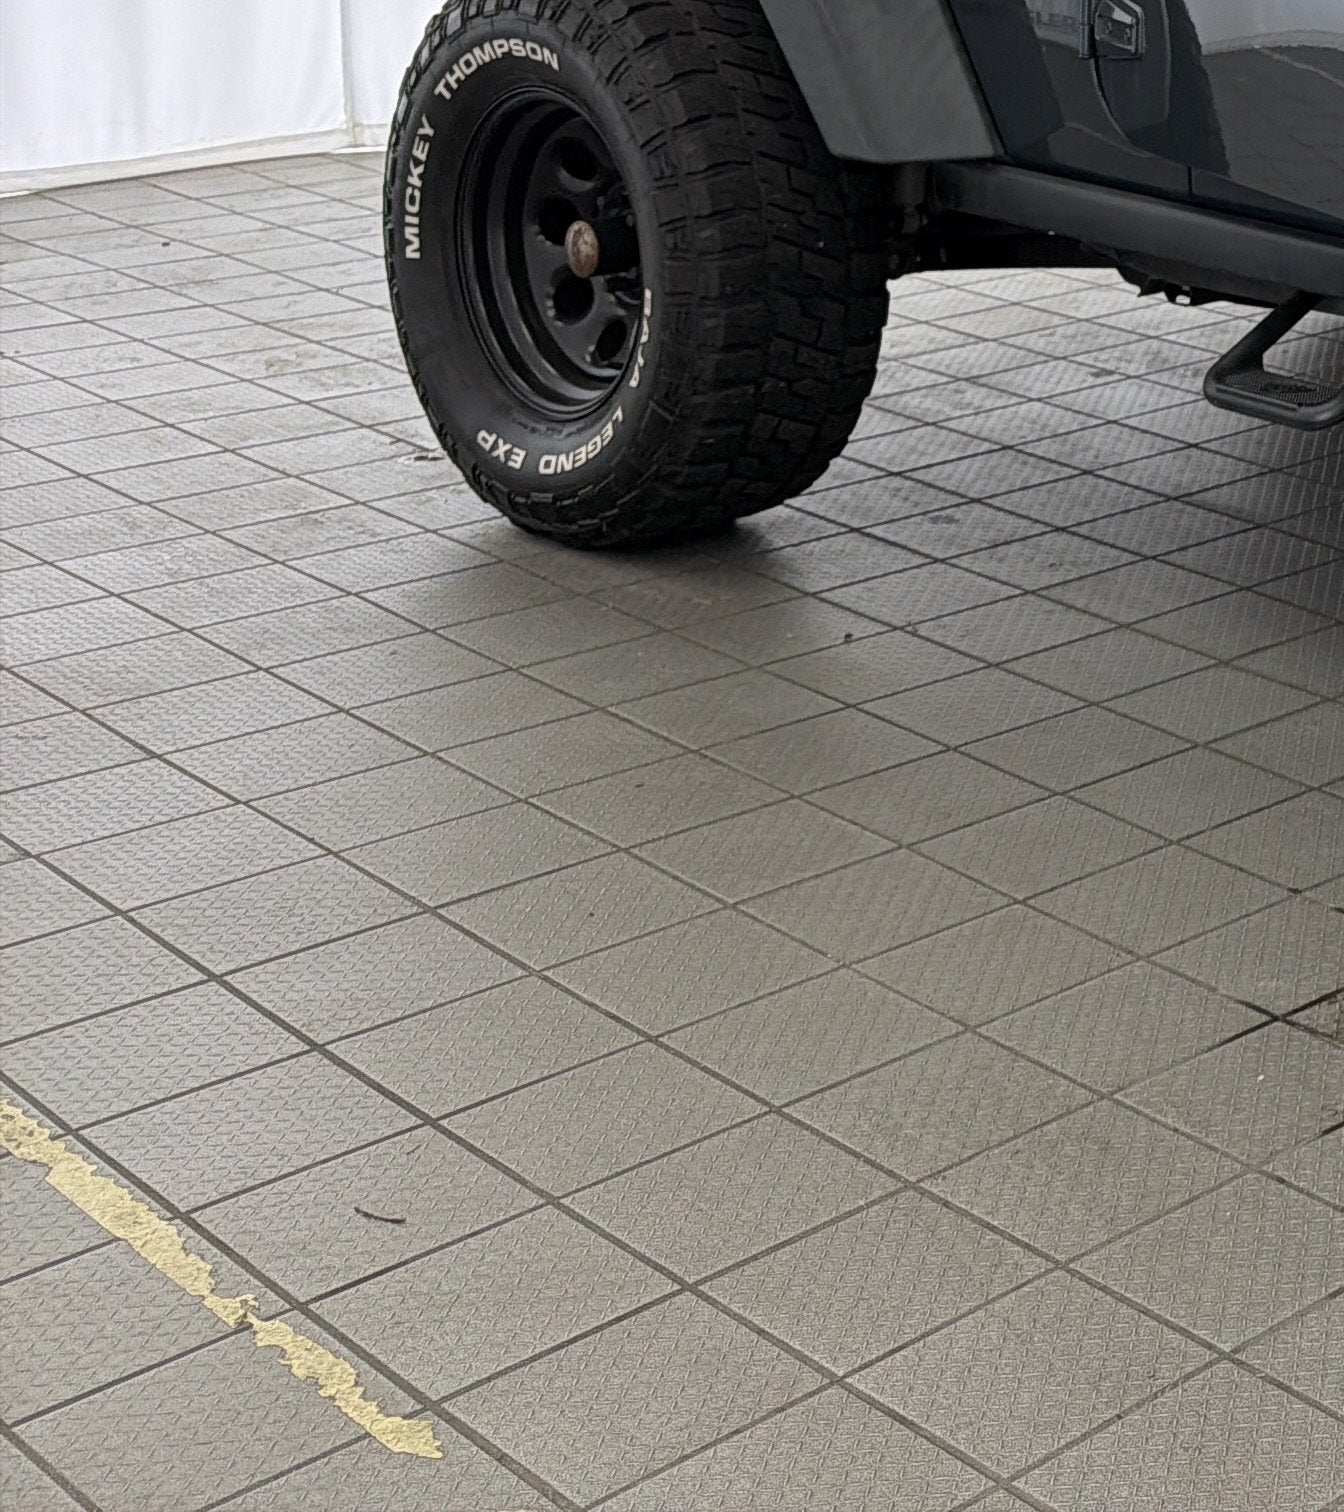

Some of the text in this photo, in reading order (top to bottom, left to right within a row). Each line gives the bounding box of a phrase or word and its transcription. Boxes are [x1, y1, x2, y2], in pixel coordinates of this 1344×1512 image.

[404, 38, 560, 259] MICKEY THOMPSON
[476, 429, 527, 470] EXP
[538, 405, 623, 475] LEGEND
